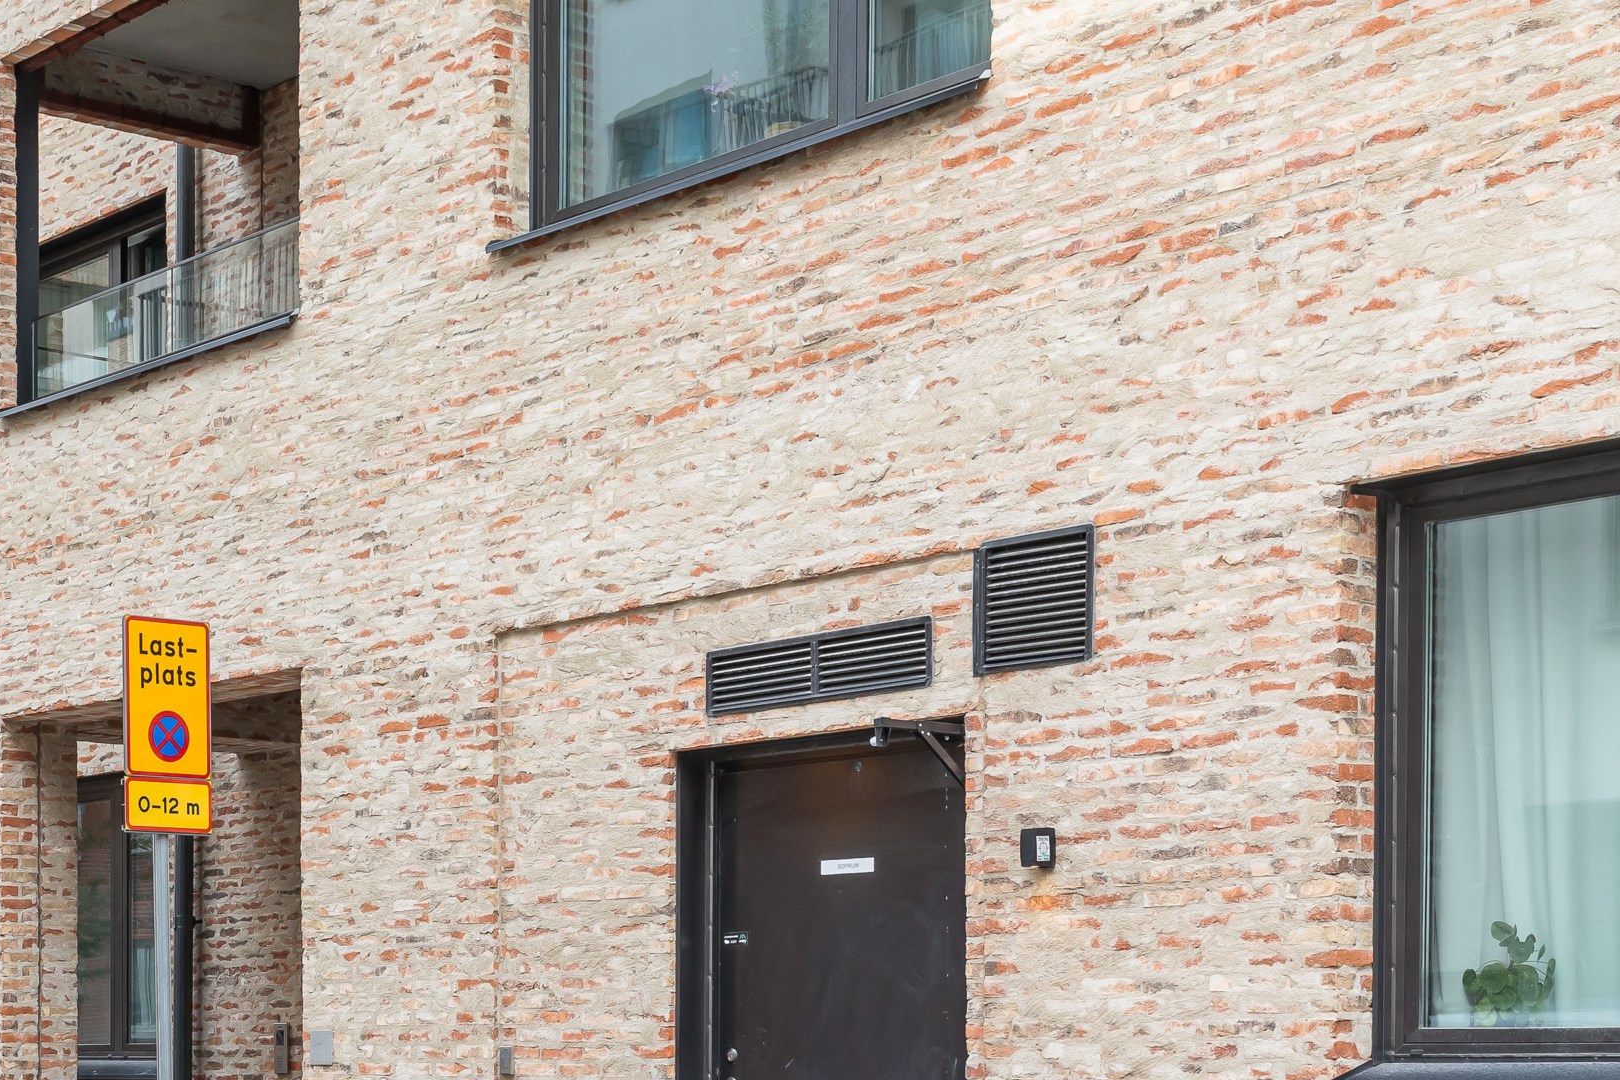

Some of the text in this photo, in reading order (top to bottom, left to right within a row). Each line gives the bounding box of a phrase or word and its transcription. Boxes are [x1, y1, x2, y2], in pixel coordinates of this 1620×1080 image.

[138, 632, 198, 658] Last-
[140, 662, 197, 689] plats
[138, 795, 201, 816] 0-12 m
